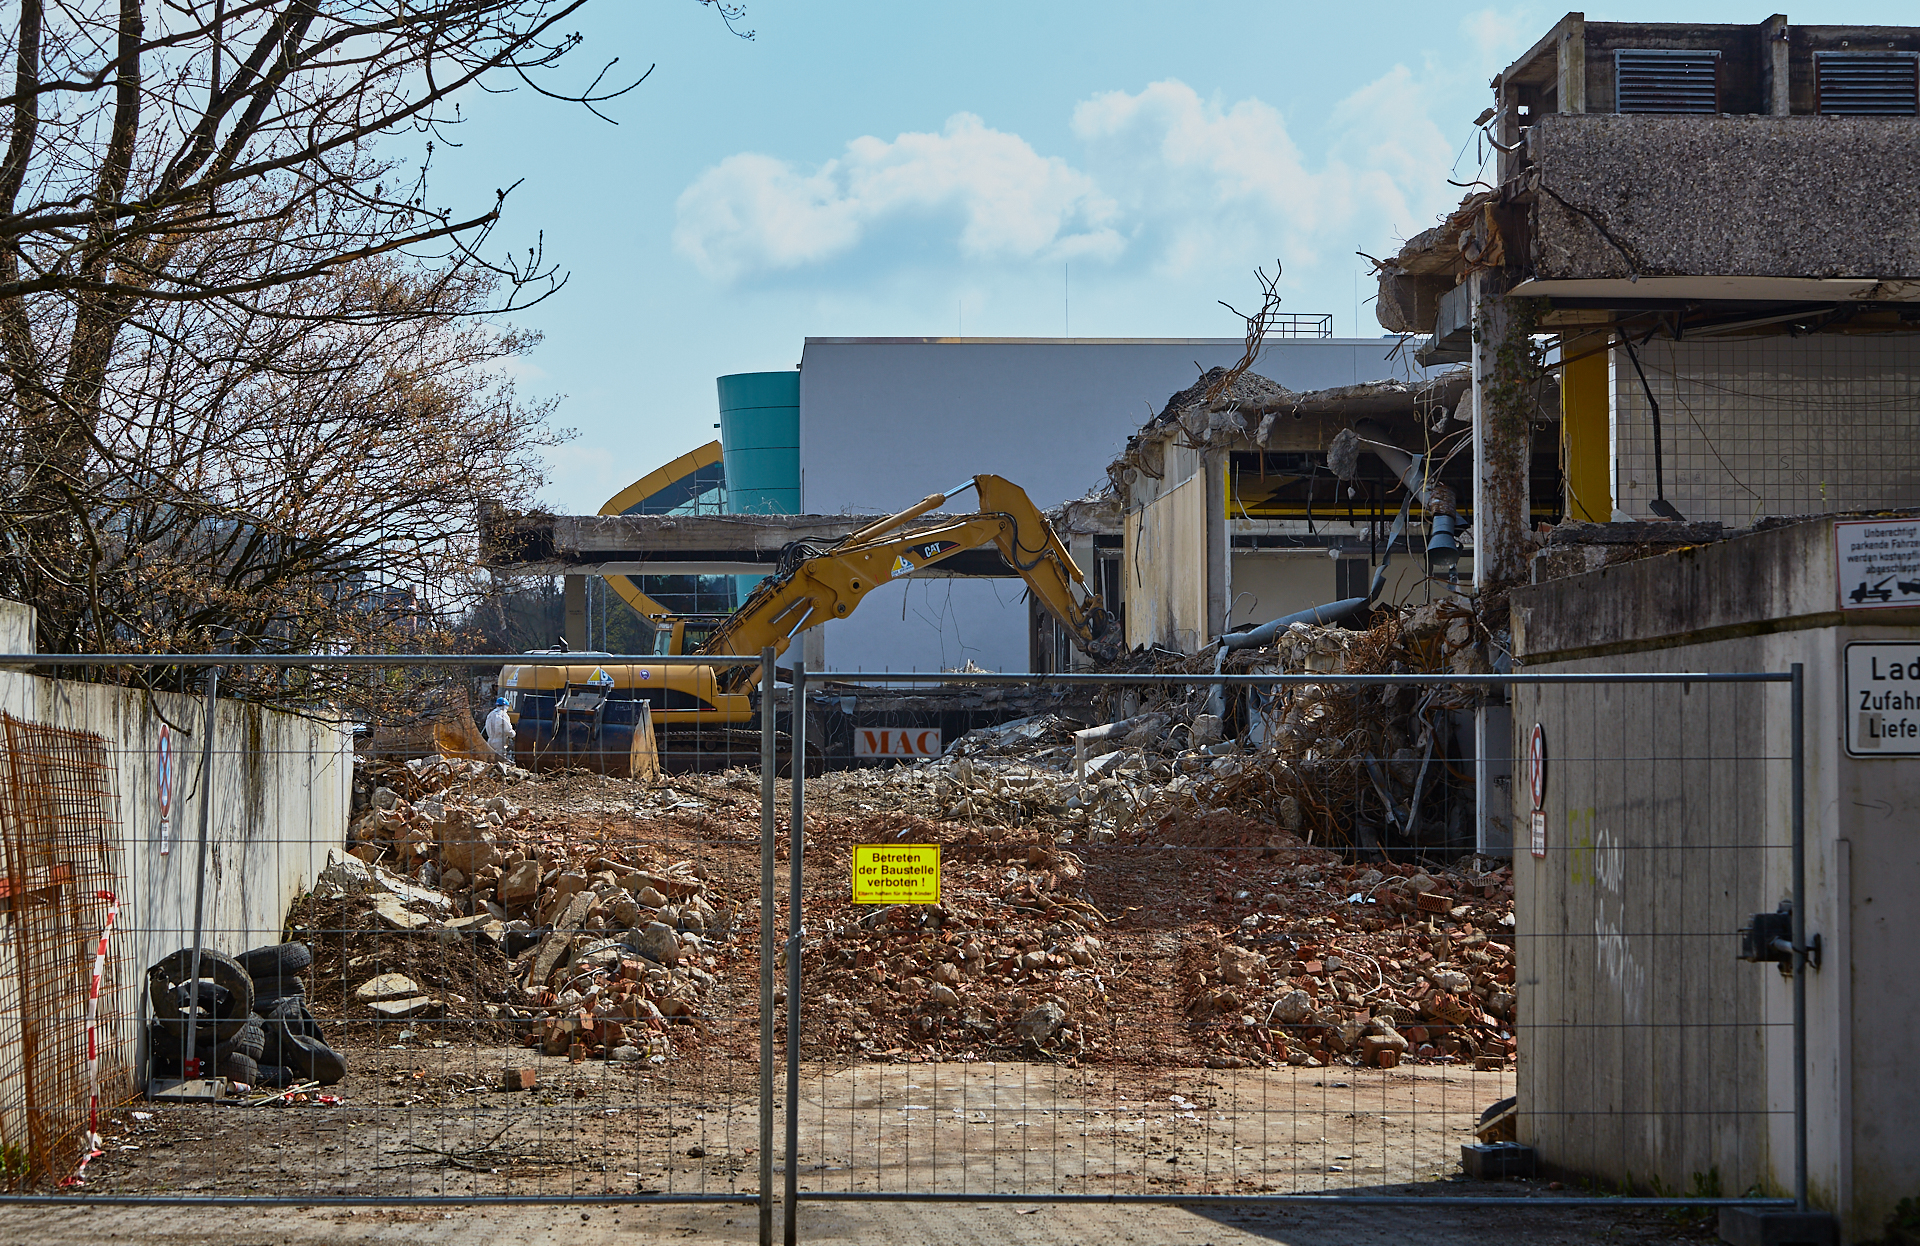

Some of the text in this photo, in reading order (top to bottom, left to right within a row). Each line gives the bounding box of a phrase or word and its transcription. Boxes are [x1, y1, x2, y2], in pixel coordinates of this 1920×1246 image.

[1864, 527, 1917, 538] Unberechtigt
[924, 542, 941, 558] CAT
[1850, 540, 1889, 552] parkende
[1847, 553, 1878, 563] werden
[1870, 718, 1920, 738] Liefe
[861, 730, 940, 755] MAC
[872, 852, 921, 863] Betreten
[858, 865, 934, 875] der Baustelle
[867, 877, 918, 887] verboten
